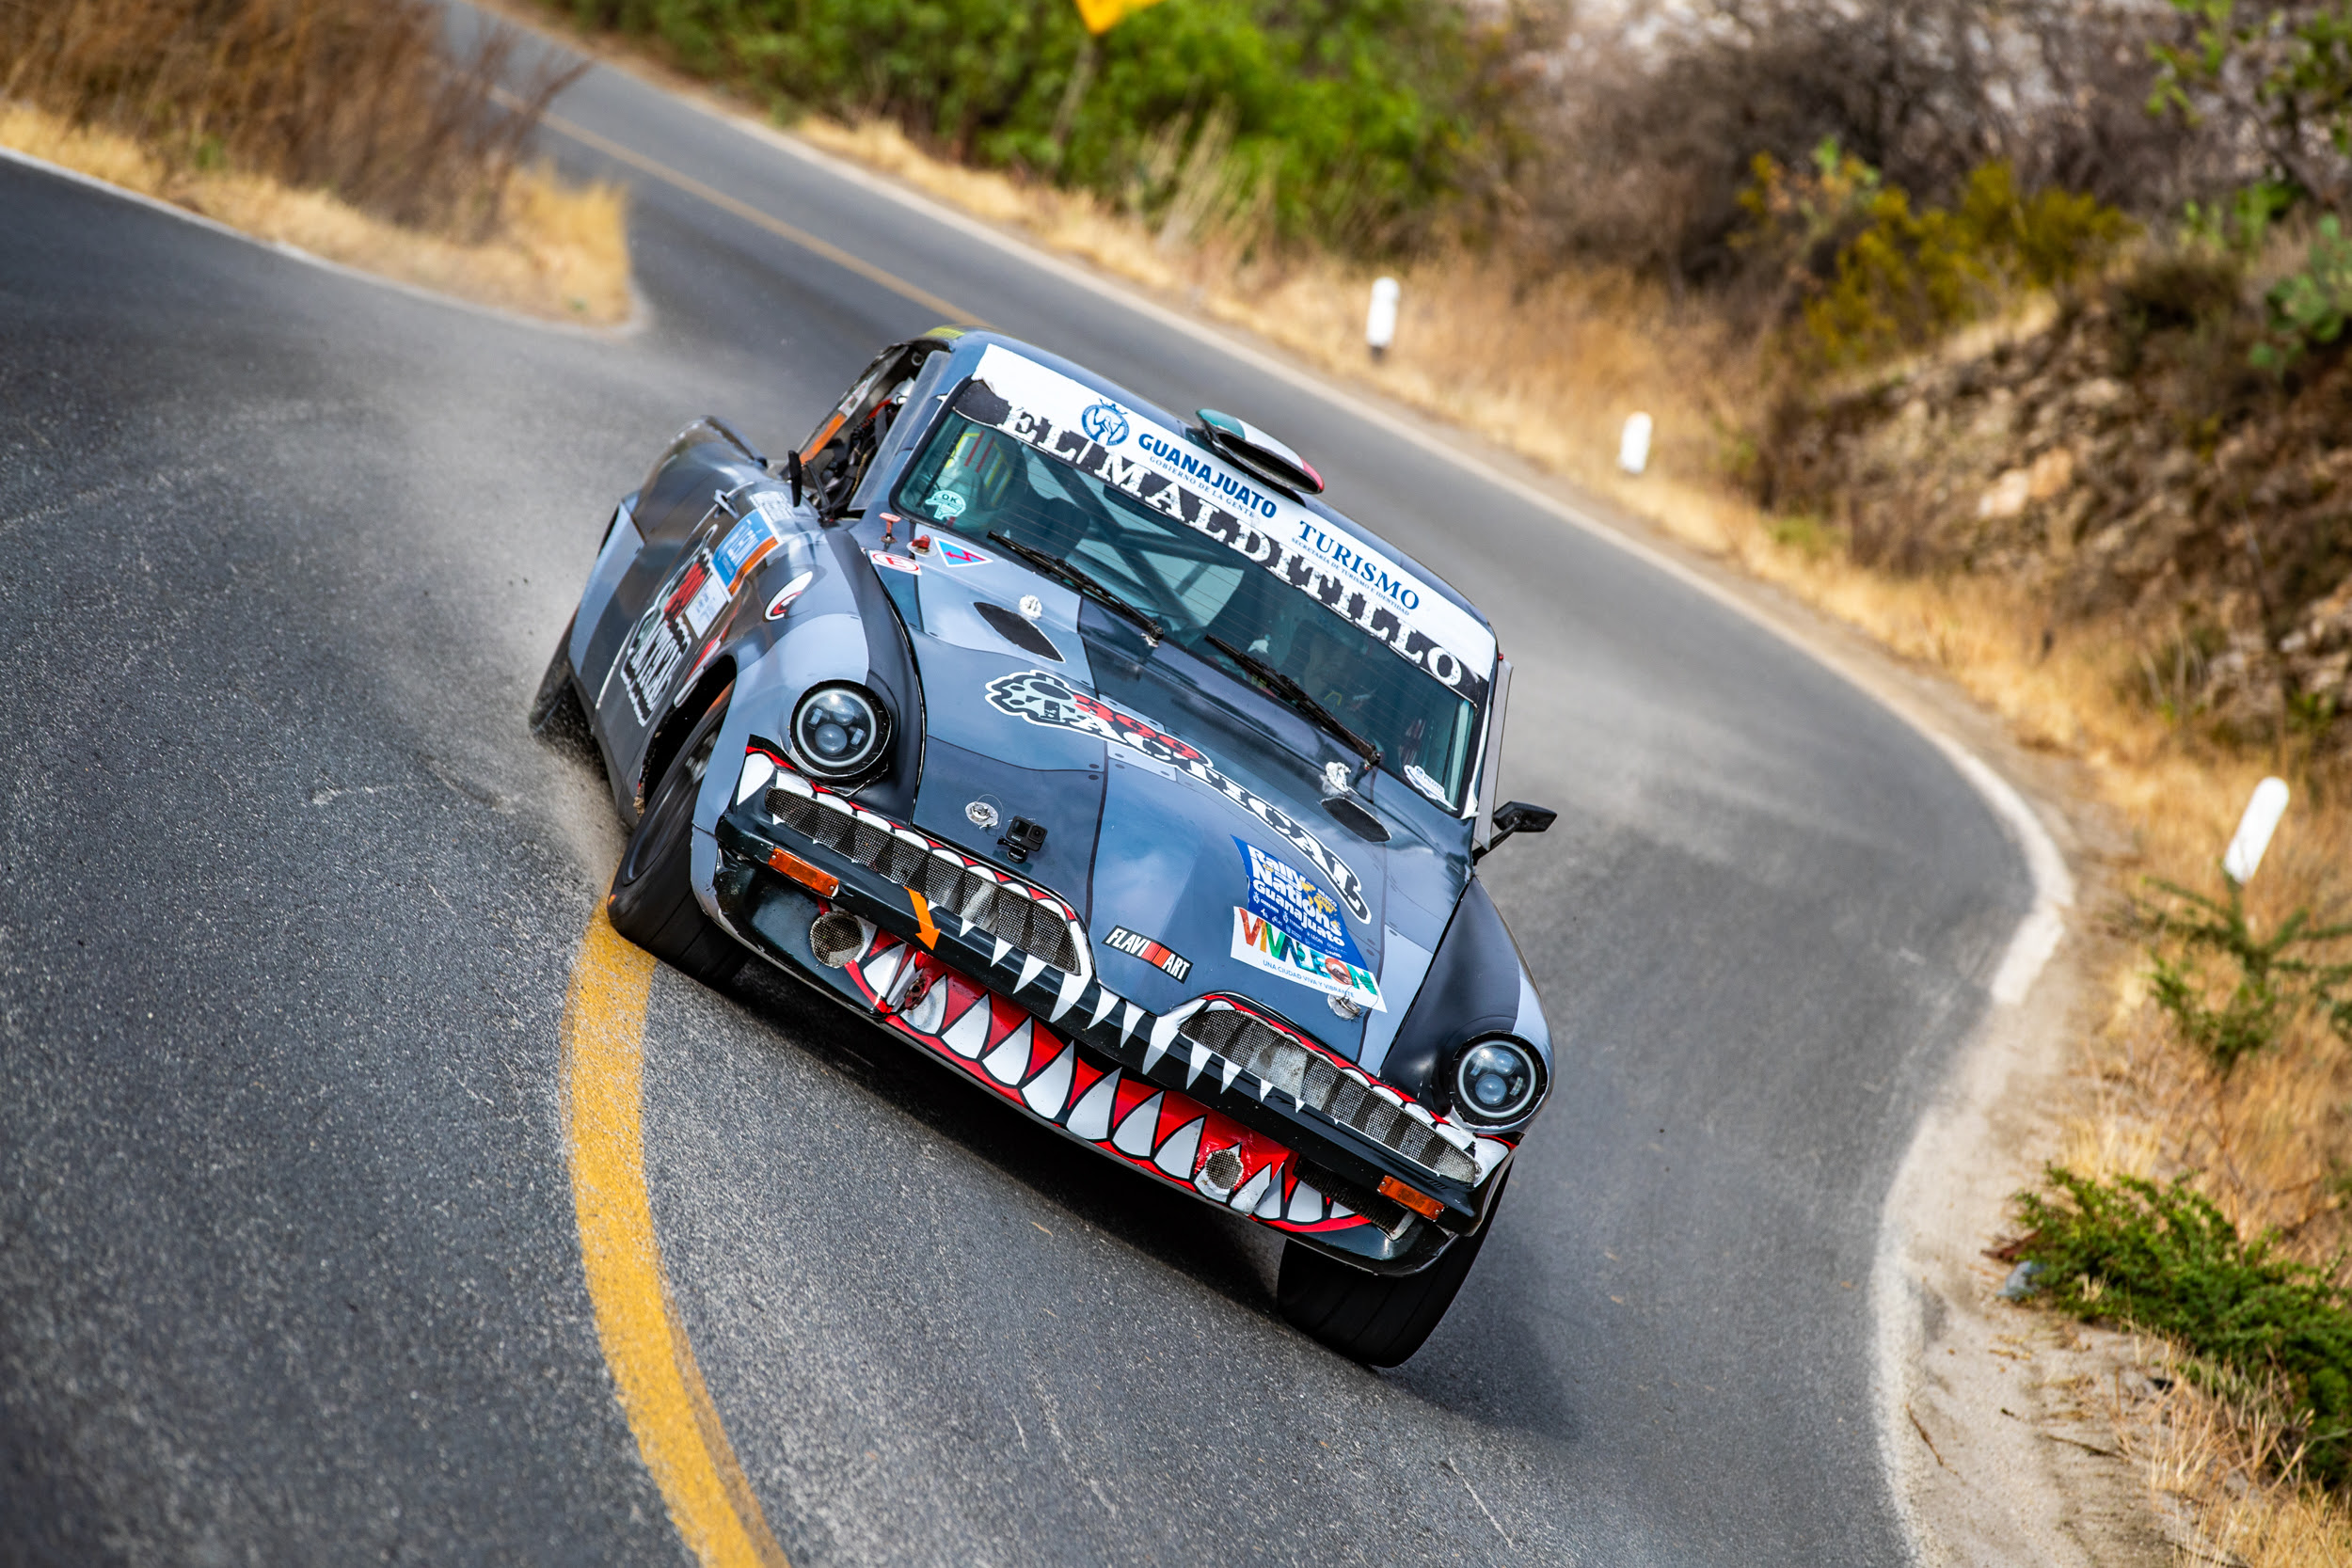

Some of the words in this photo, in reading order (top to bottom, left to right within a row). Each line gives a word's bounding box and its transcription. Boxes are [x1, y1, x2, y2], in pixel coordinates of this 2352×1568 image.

[1138, 433, 1278, 519] GUANAJUATO
[1150, 455, 1197, 486] GOBIERNO
[1199, 483, 1209, 494] DE
[1212, 489, 1223, 500] LA
[1226, 497, 1255, 518] GENTE
[997, 402, 1076, 462] EL
[1094, 448, 1462, 687] MALDITILLO
[1292, 537, 1330, 565] SECRETARÍA
[1331, 561, 1342, 570] DE
[1342, 566, 1371, 590] TURISMO
[1375, 590, 1410, 616] IDENTIDAD
[1298, 520, 1420, 610] TURISMO
[1247, 844, 1307, 892] Rally
[1251, 856, 1343, 937] Nations
[1252, 879, 1345, 947] Guanajuato
[1104, 927, 1152, 958] FLAVI
[1161, 953, 1191, 980] ART
[1263, 959, 1278, 971] UNA
[1277, 966, 1302, 980] CIUDAD
